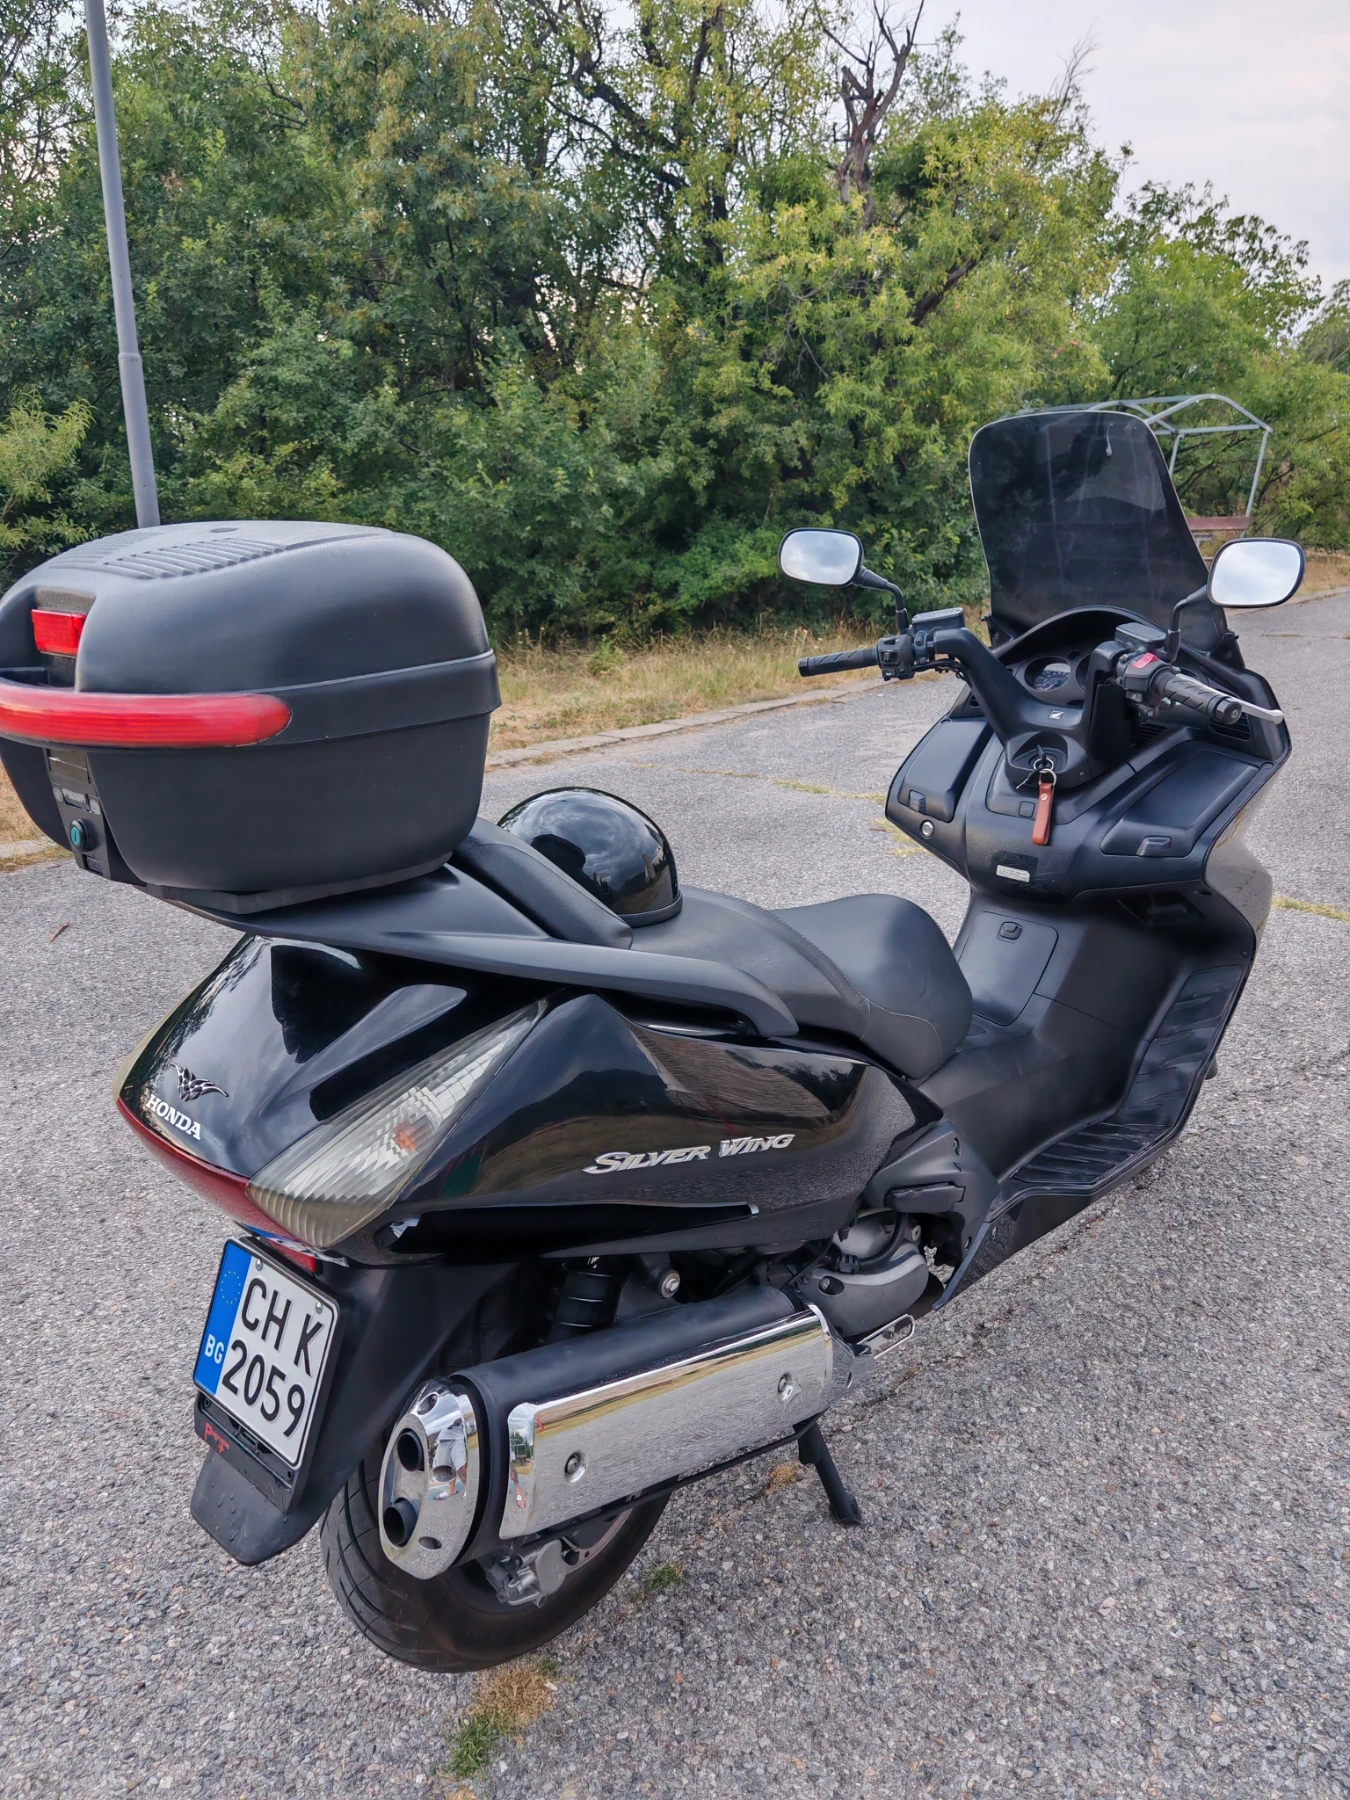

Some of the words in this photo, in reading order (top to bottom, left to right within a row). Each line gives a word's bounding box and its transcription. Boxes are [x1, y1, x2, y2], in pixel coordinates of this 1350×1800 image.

[146, 1094, 201, 1140] HONDA
[582, 1146, 711, 1174] SILVER
[719, 1134, 796, 1158] WING
[204, 1334, 225, 1364] BG
[241, 1277, 292, 1351] CH
[293, 1313, 323, 1377] K
[222, 1339, 306, 1438] 2059
